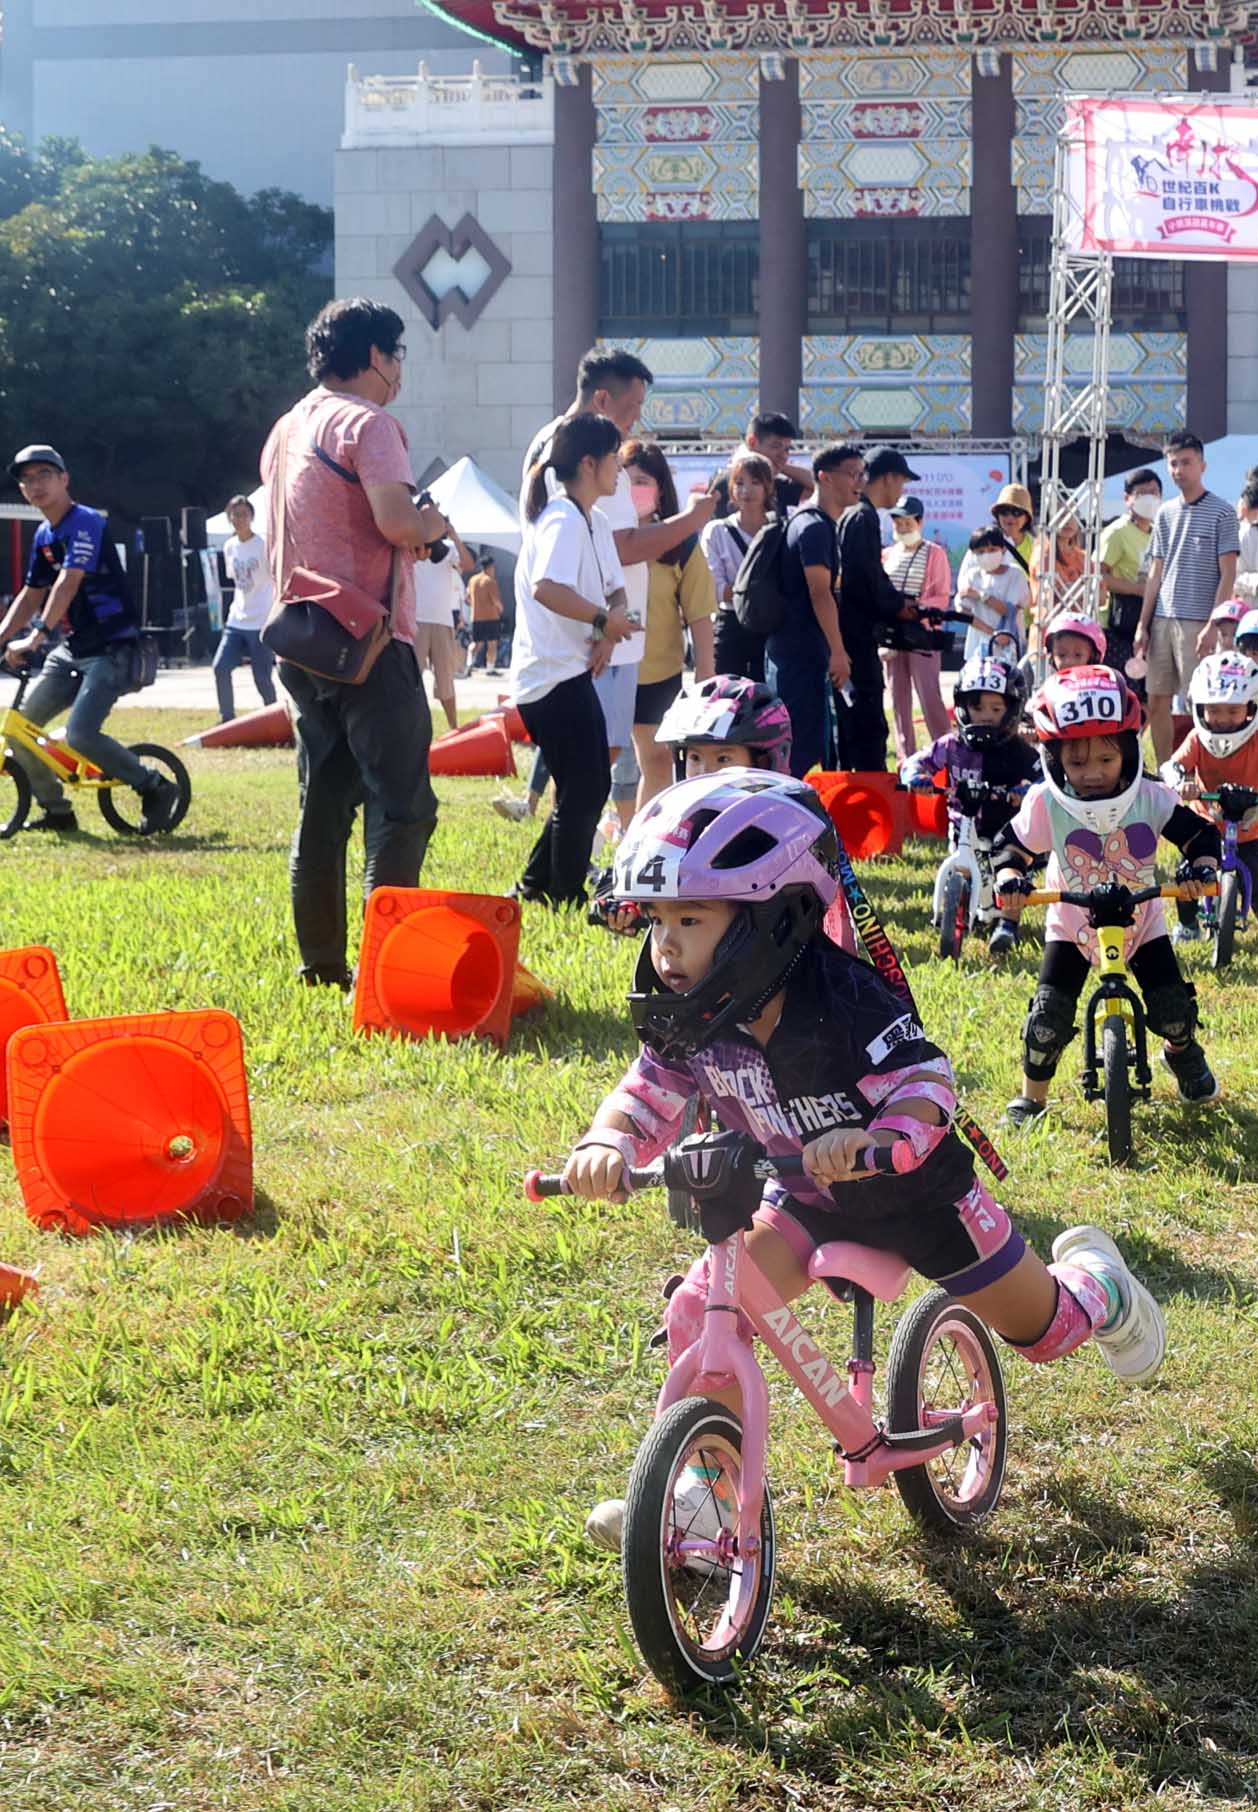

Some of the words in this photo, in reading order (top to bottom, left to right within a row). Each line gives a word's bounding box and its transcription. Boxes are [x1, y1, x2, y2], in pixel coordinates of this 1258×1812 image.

[1162, 180, 1220, 195] 世紀百K
[1061, 696, 1115, 722] 310
[763, 1307, 848, 1408] AICAN
